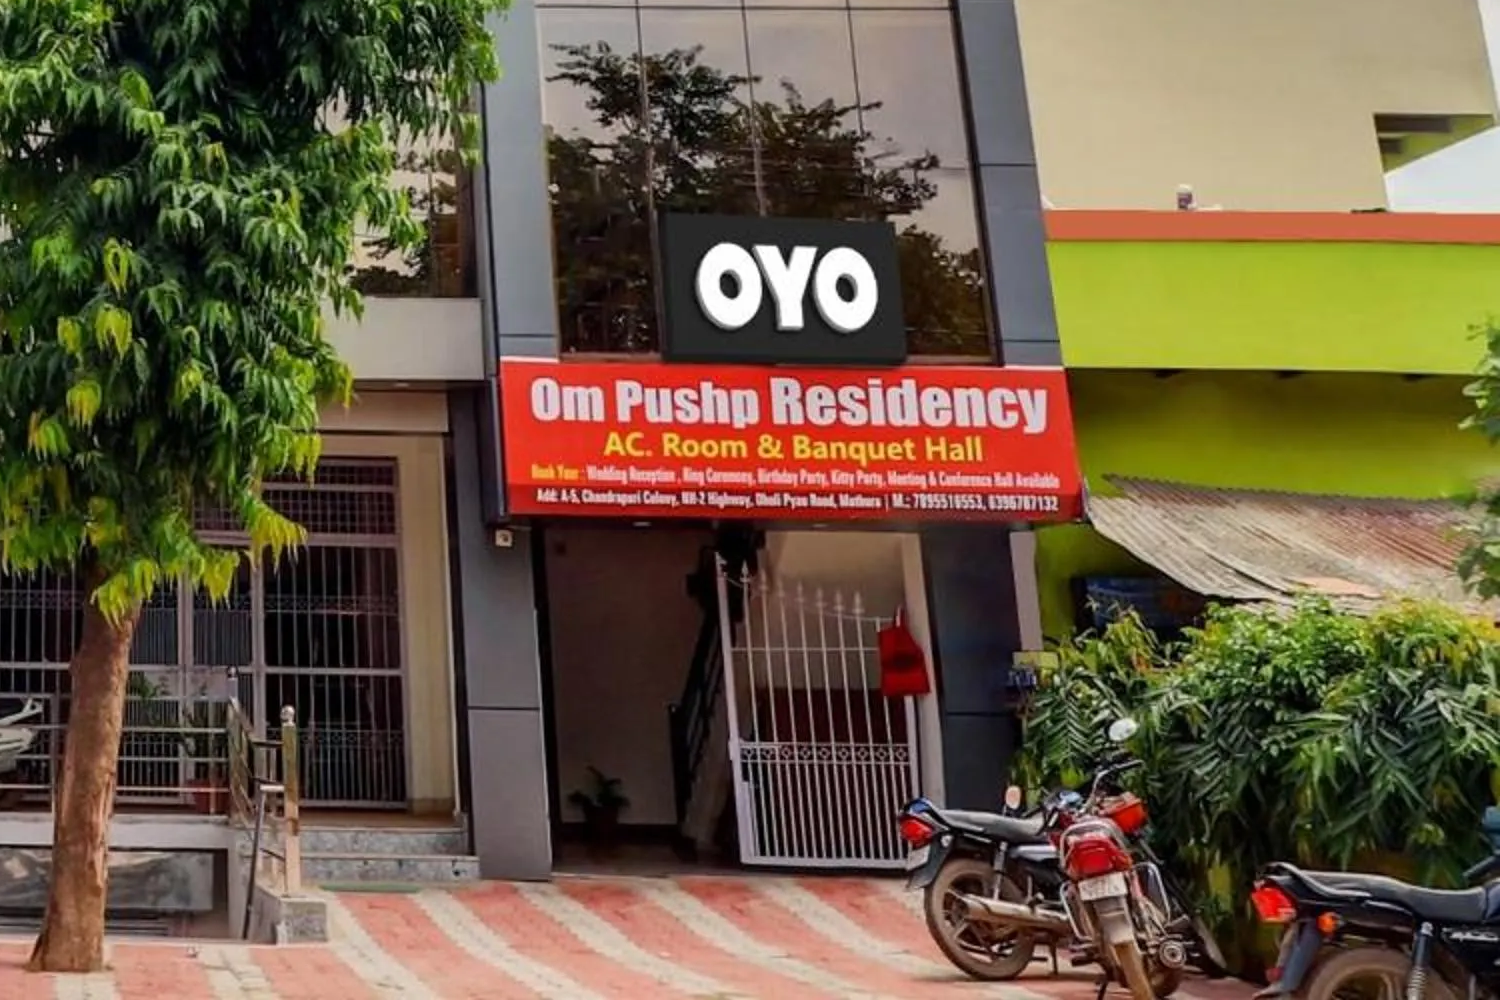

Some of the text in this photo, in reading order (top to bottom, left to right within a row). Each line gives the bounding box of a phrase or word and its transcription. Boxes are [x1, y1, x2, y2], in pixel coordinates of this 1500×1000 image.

[695, 242, 878, 333] OYO
[531, 376, 1047, 434] Om Pushp Residency
[604, 432, 983, 466] AC. Room & Banquet Hall
